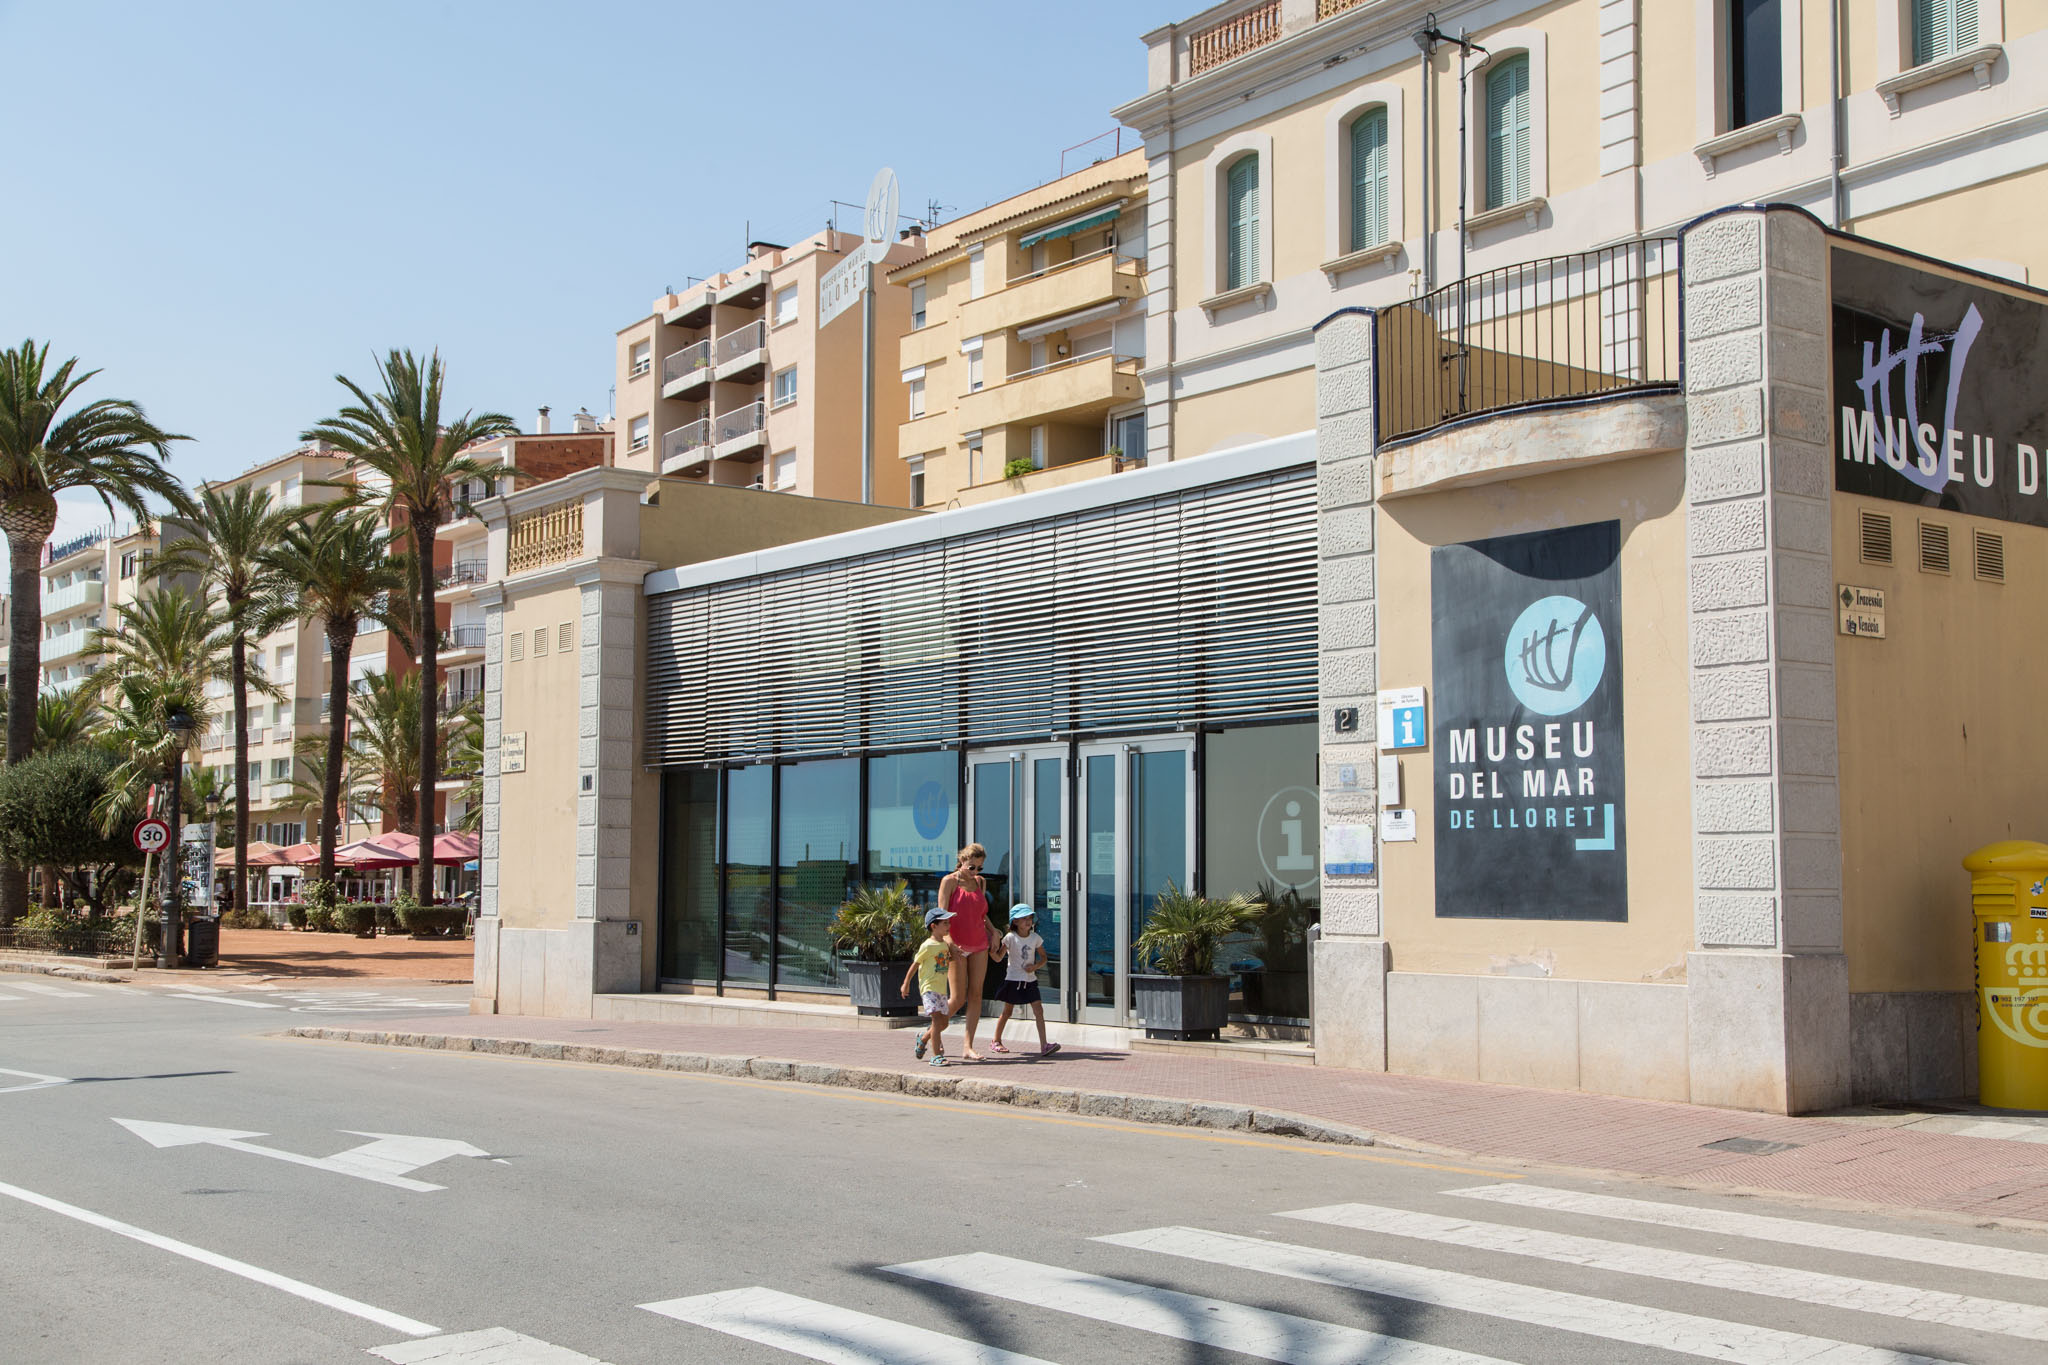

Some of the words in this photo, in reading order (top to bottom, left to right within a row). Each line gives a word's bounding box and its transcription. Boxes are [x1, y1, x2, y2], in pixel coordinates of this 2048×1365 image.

[822, 263, 868, 312] LLORET
[1842, 406, 1994, 488] MUSEU
[2018, 443, 2048, 499] D
[1340, 709, 1350, 729] 2
[1450, 721, 1594, 763] MUSEU
[1450, 771, 1504, 799] DEL
[1523, 768, 1595, 798] MAR
[1450, 809, 1475, 829] DE
[1493, 806, 1595, 828] LLORET
[142, 830, 163, 841] 30
[890, 855, 943, 868] LLORET
[2030, 909, 2047, 917] BNK
